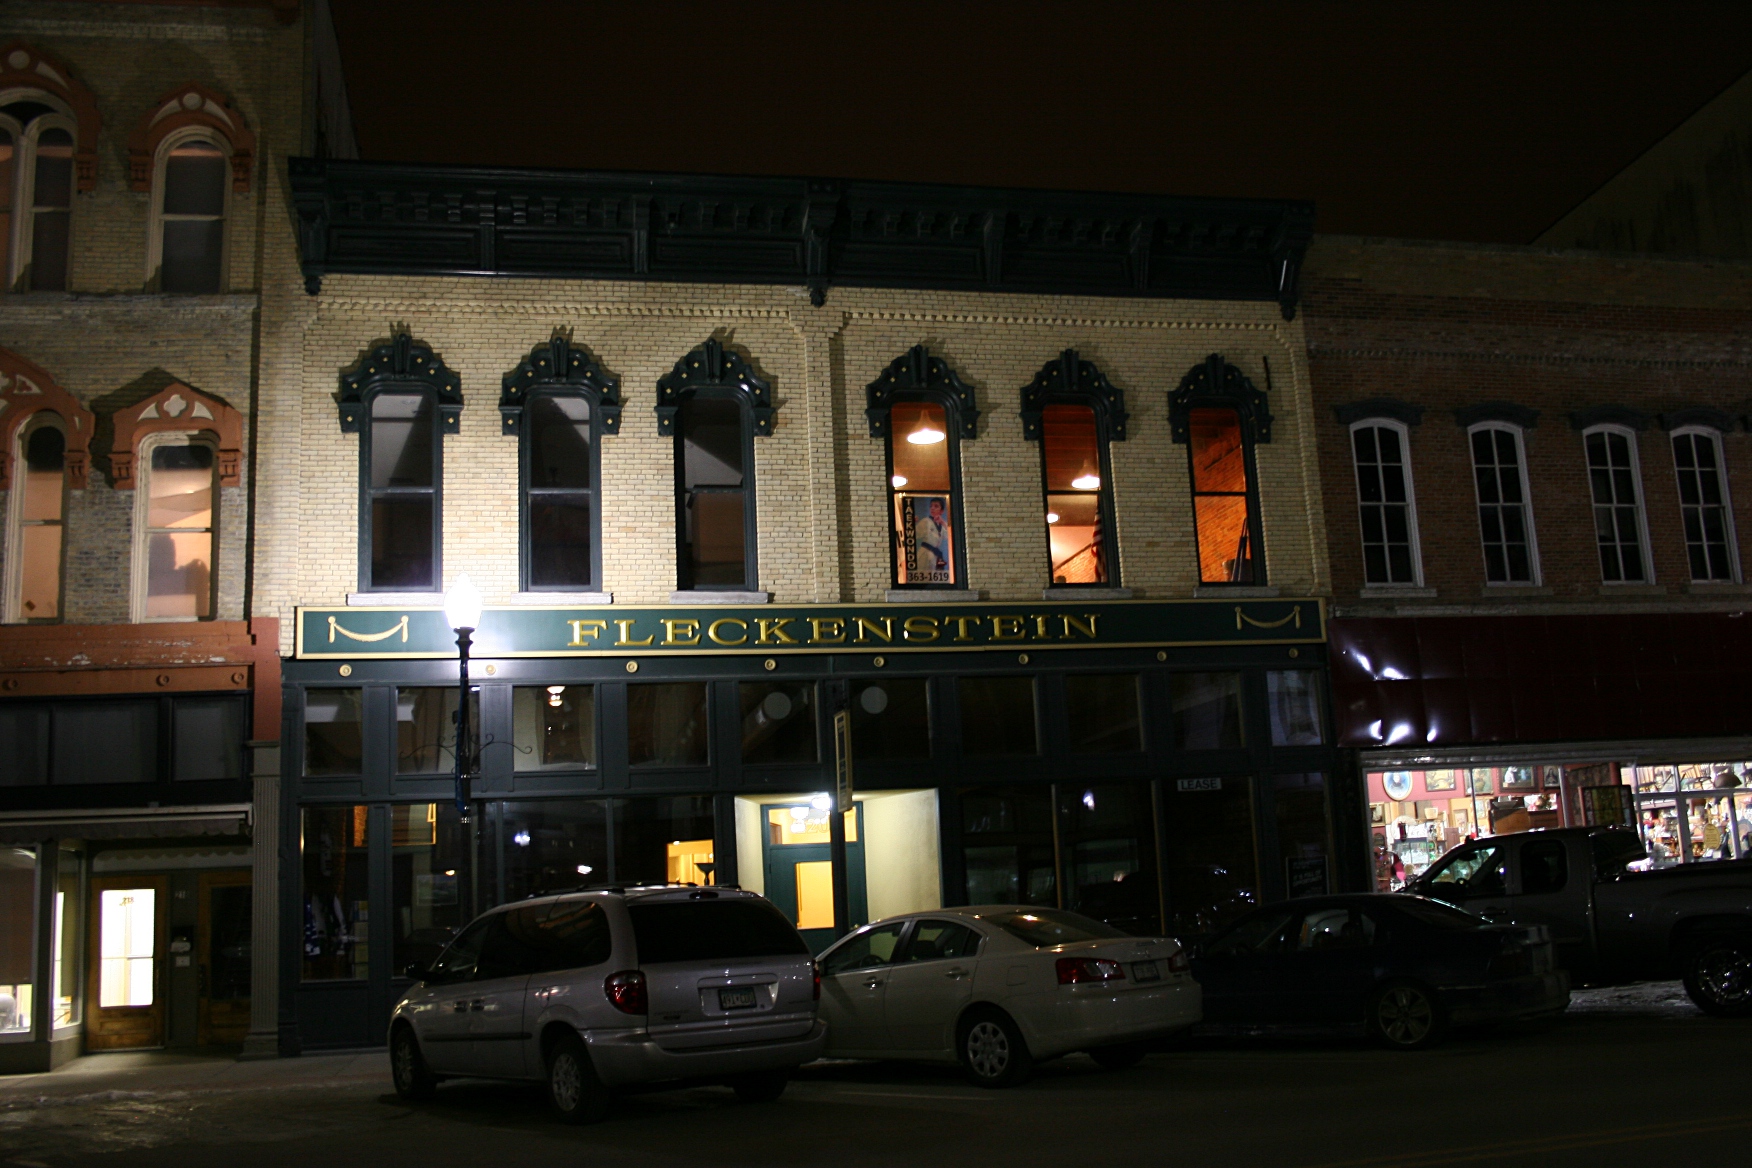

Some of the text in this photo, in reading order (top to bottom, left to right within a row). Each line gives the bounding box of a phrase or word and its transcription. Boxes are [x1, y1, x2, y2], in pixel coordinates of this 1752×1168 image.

[905, 498, 916, 570] TAEKWONDO
[908, 571, 949, 582] 363-1619
[567, 613, 1100, 647] FLECKENSTEIN
[1181, 779, 1218, 790] LEASE
